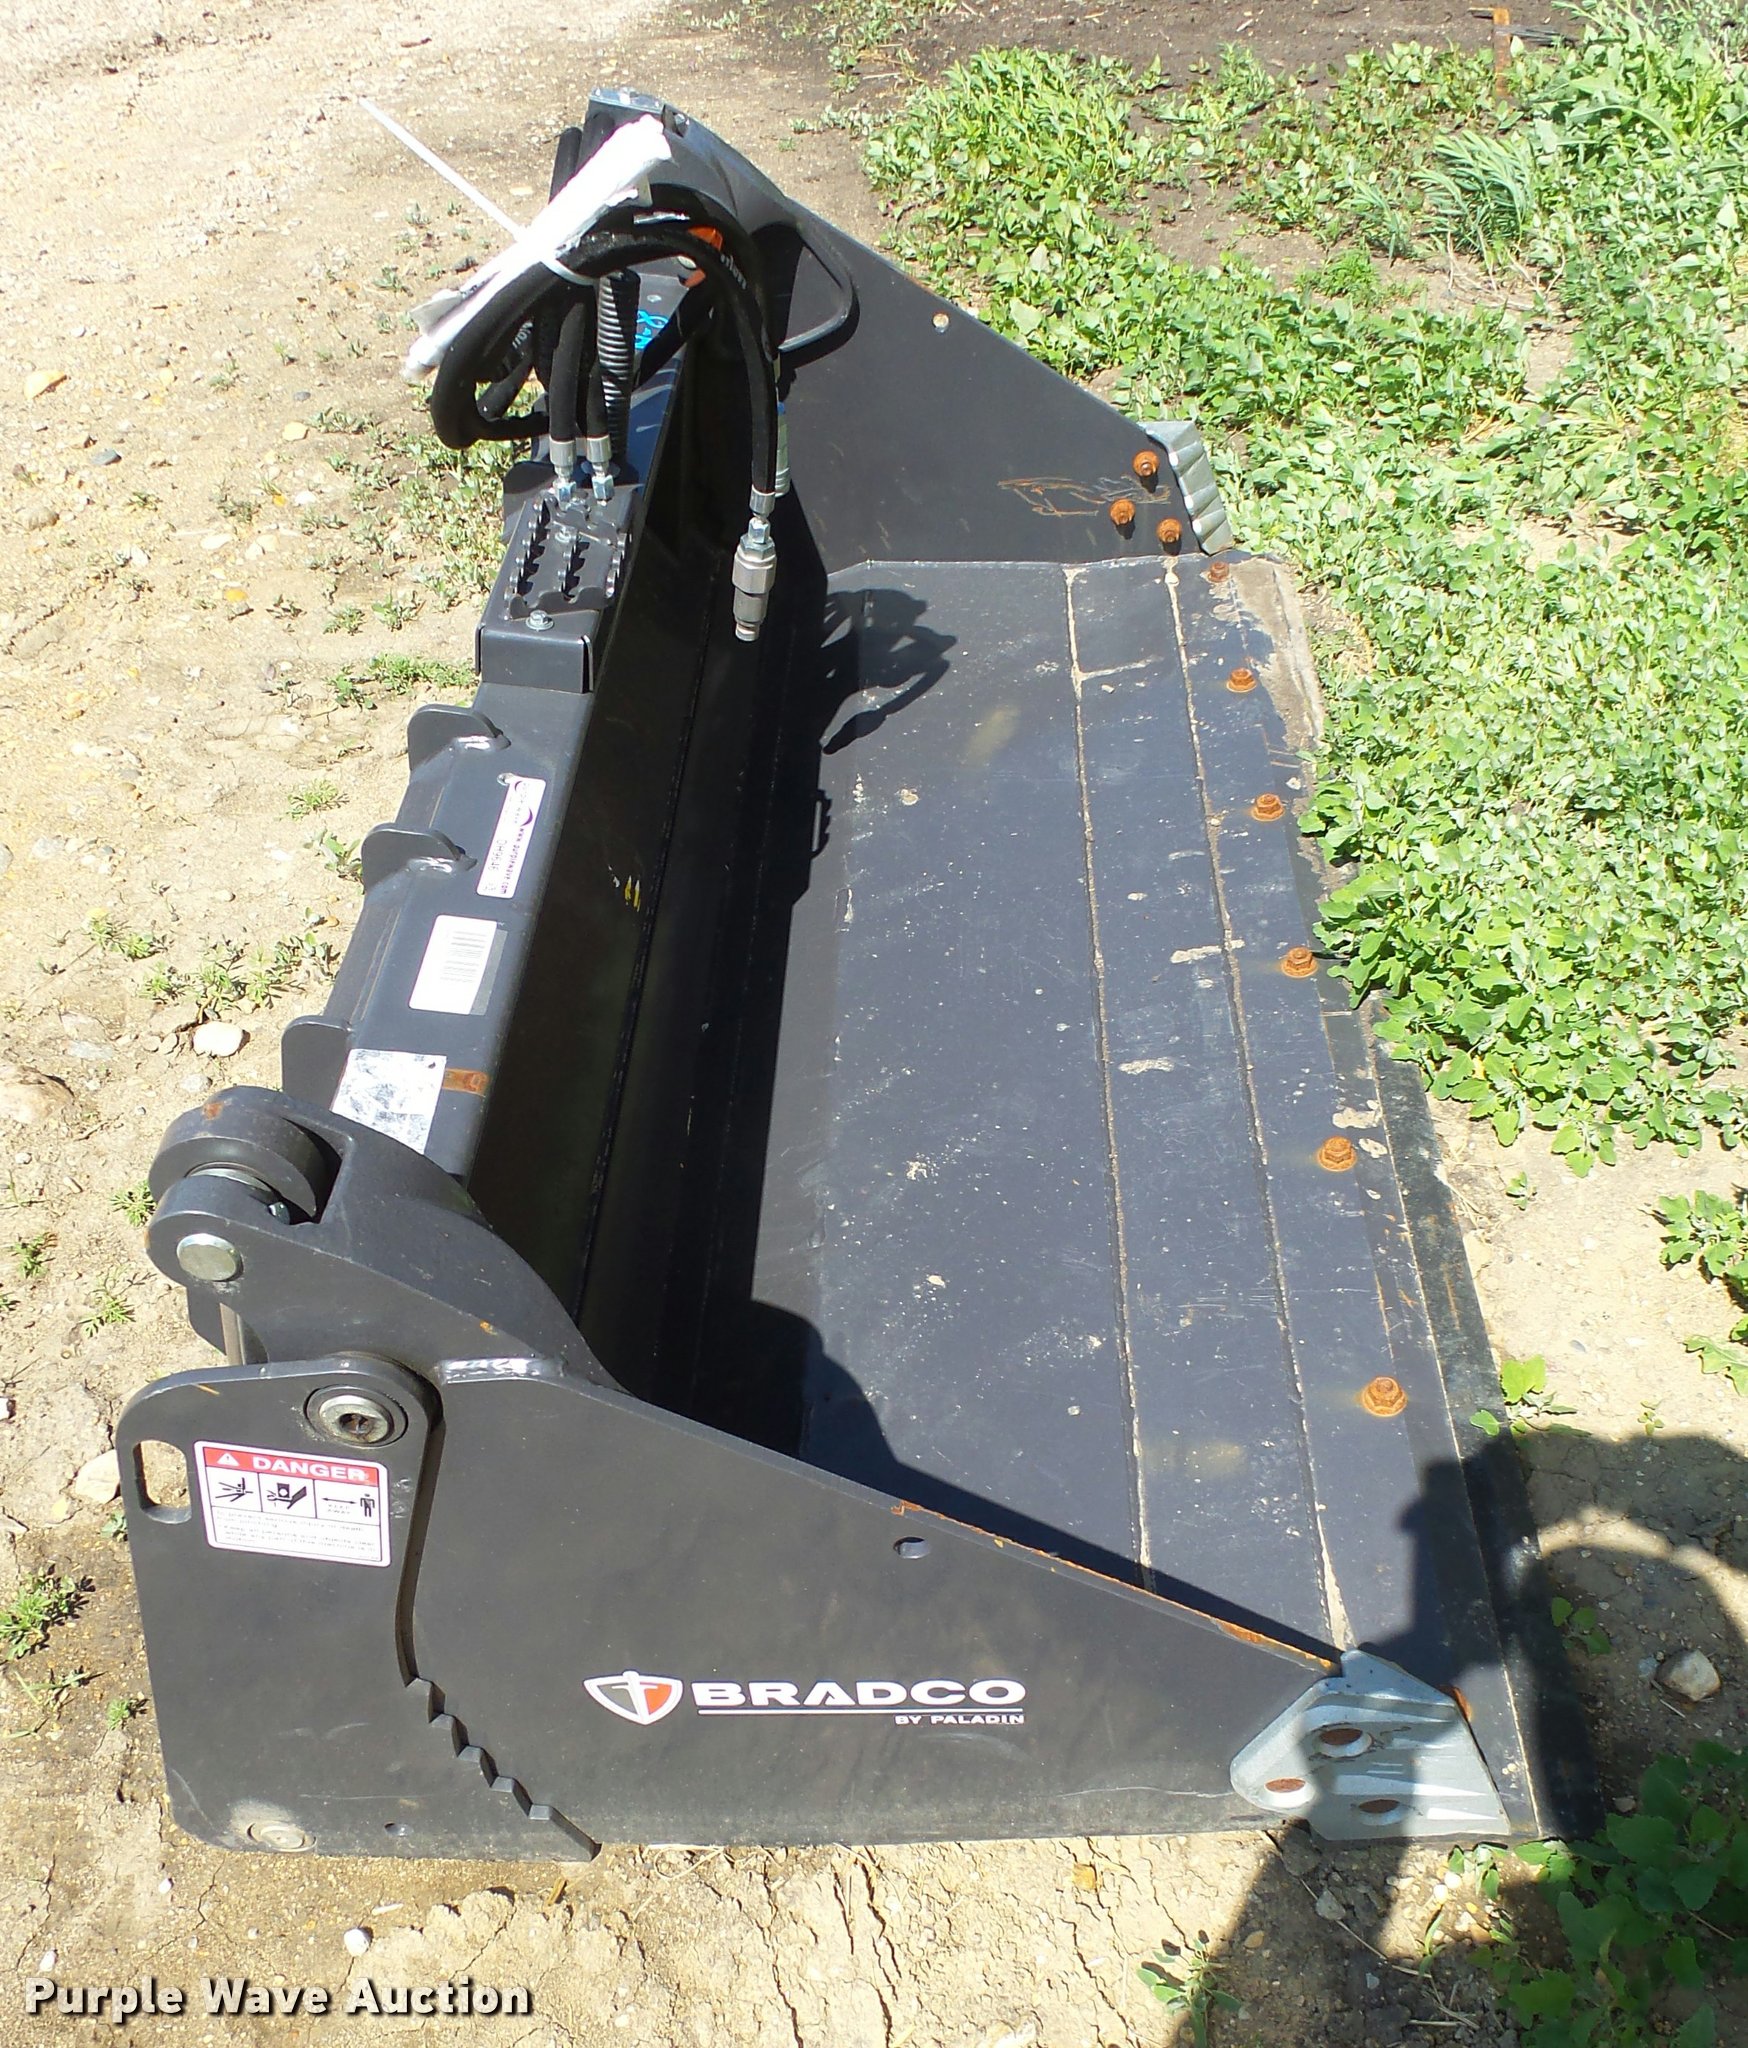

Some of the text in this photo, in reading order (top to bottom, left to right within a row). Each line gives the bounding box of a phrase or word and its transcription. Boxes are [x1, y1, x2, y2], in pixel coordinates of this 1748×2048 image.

[252, 1456, 366, 1481] DANGER
[691, 1678, 1026, 1706] BRADCO
[894, 1714, 1025, 1725] BY PALADIN
